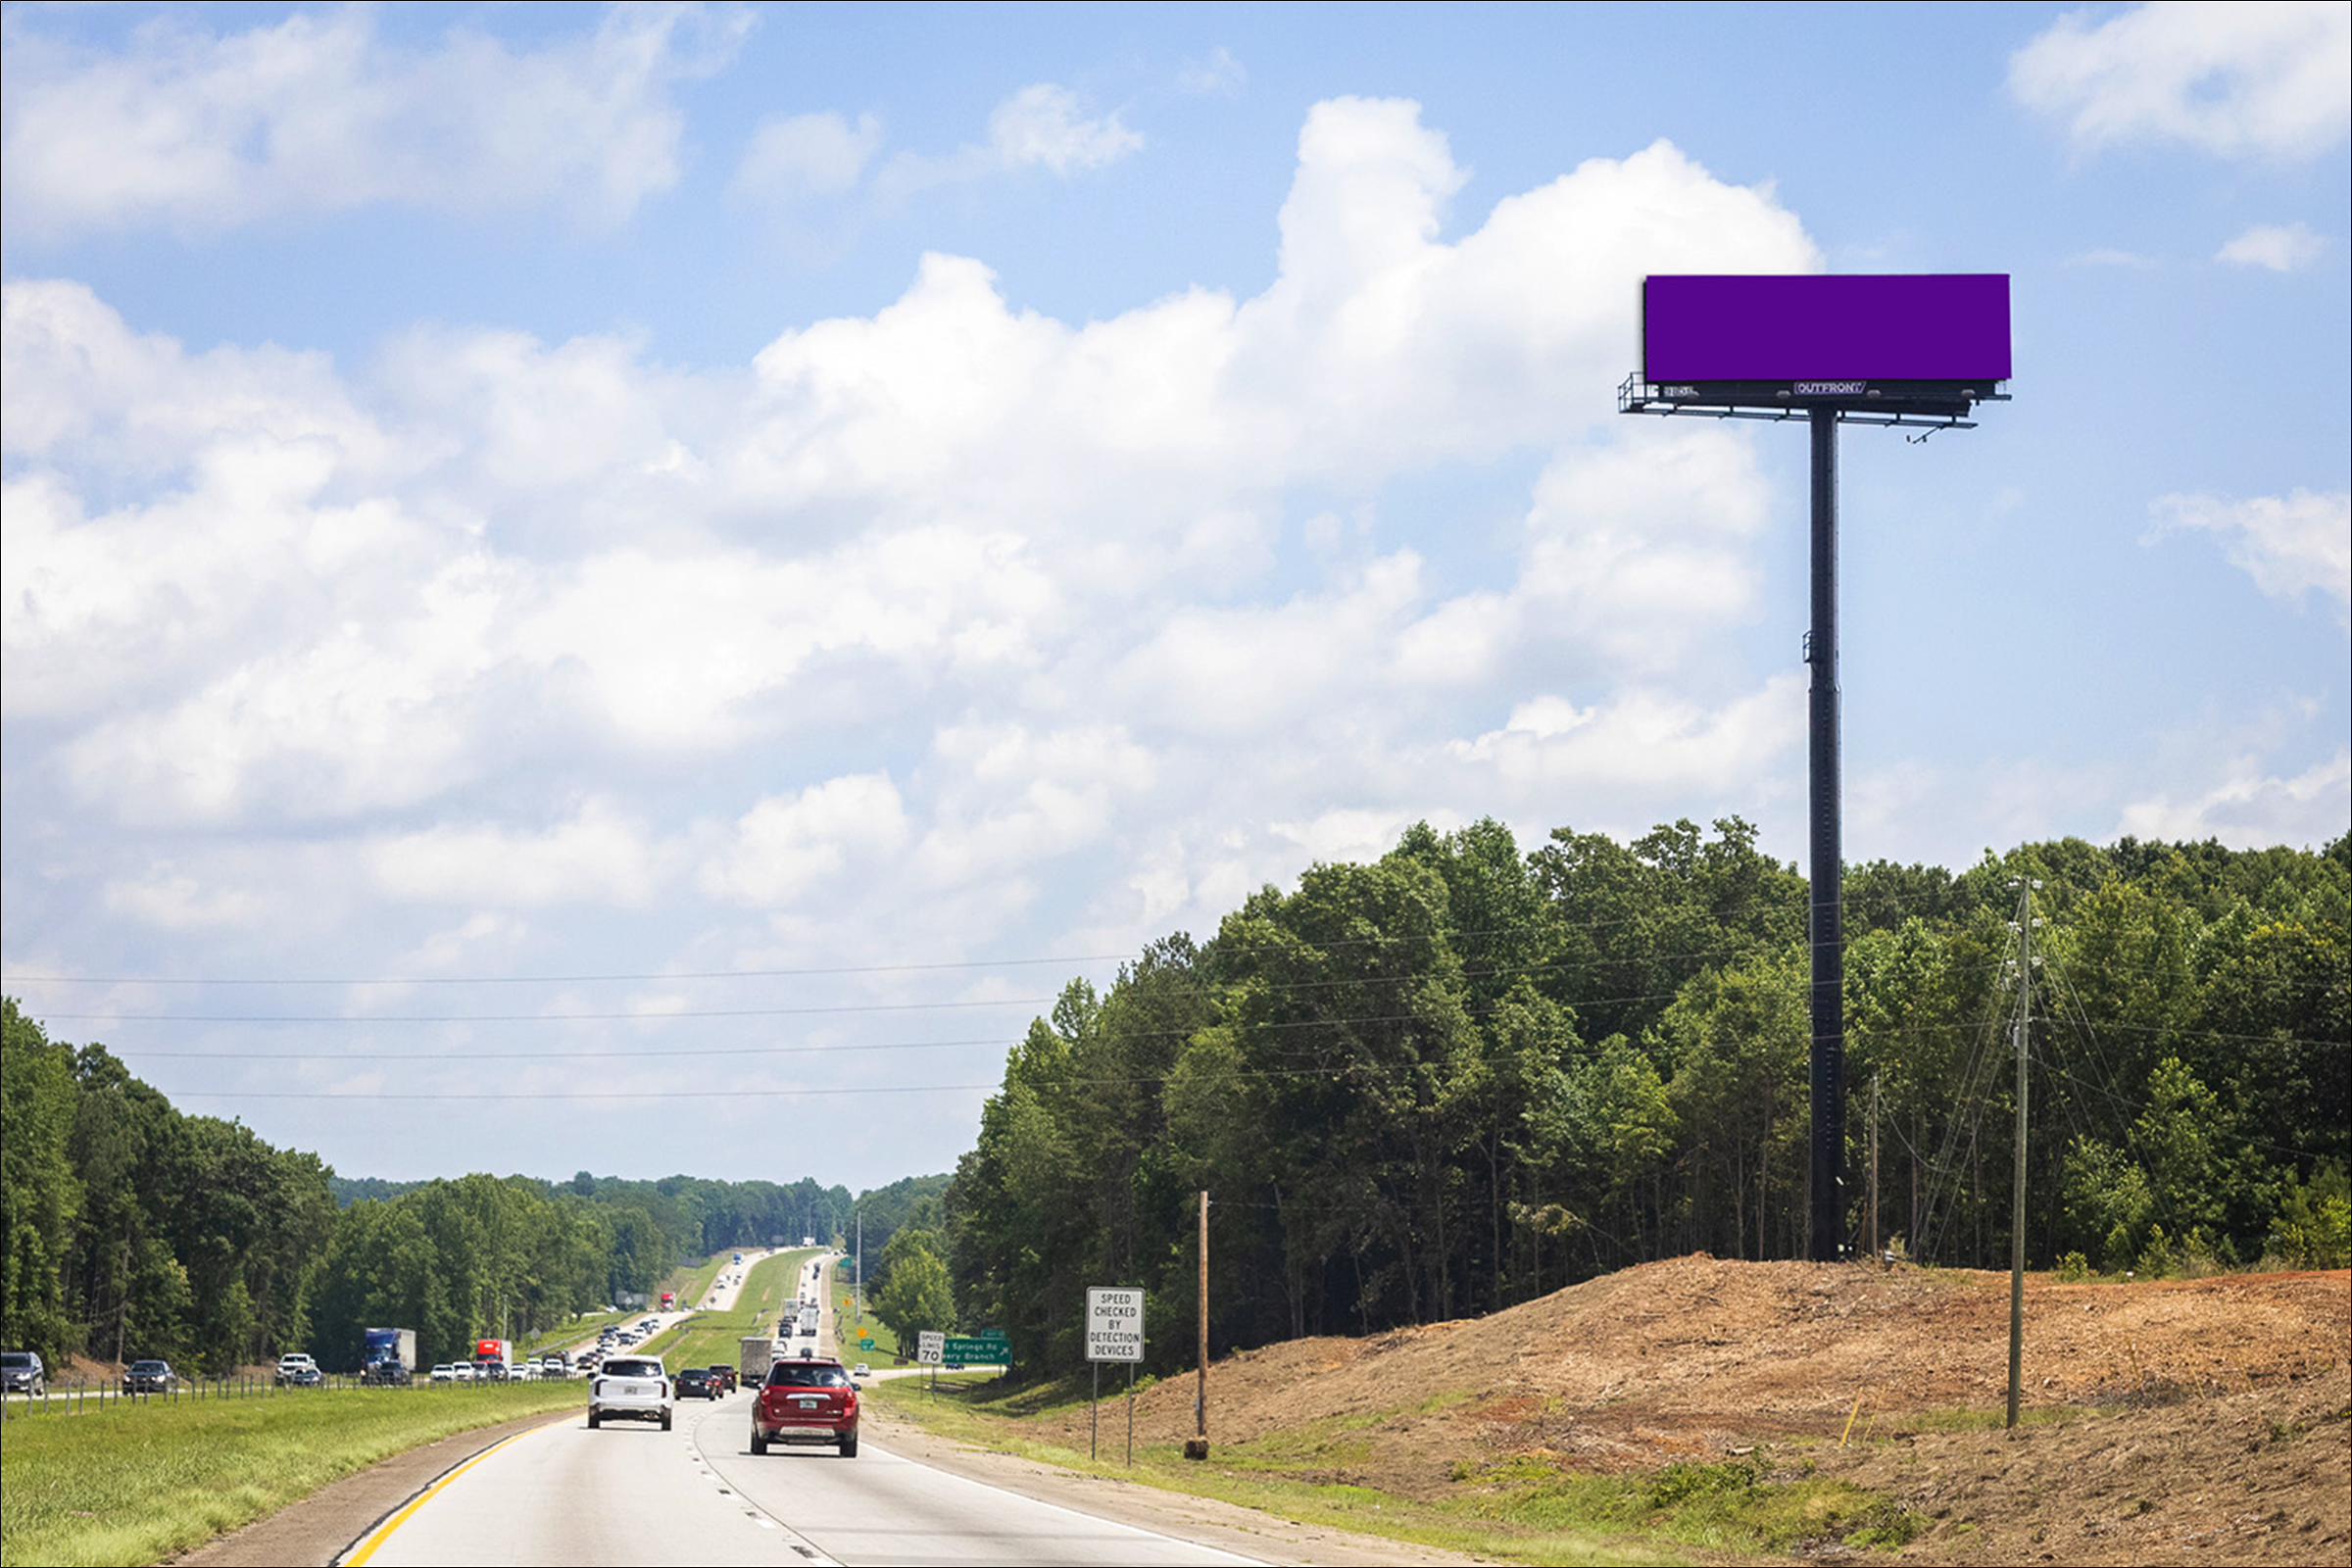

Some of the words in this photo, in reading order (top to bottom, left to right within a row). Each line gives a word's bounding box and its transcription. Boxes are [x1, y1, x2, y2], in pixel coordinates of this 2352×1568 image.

[1797, 381, 1863, 393] OUTFRONT
[1101, 1294, 1131, 1304] SPEED
[1095, 1306, 1137, 1317] CHECKED
[1108, 1319, 1122, 1330] BY
[1090, 1332, 1140, 1343] DETECTION
[953, 1343, 983, 1351] Springs
[1095, 1345, 1134, 1355] DEVICES
[922, 1350, 939, 1361] 70
